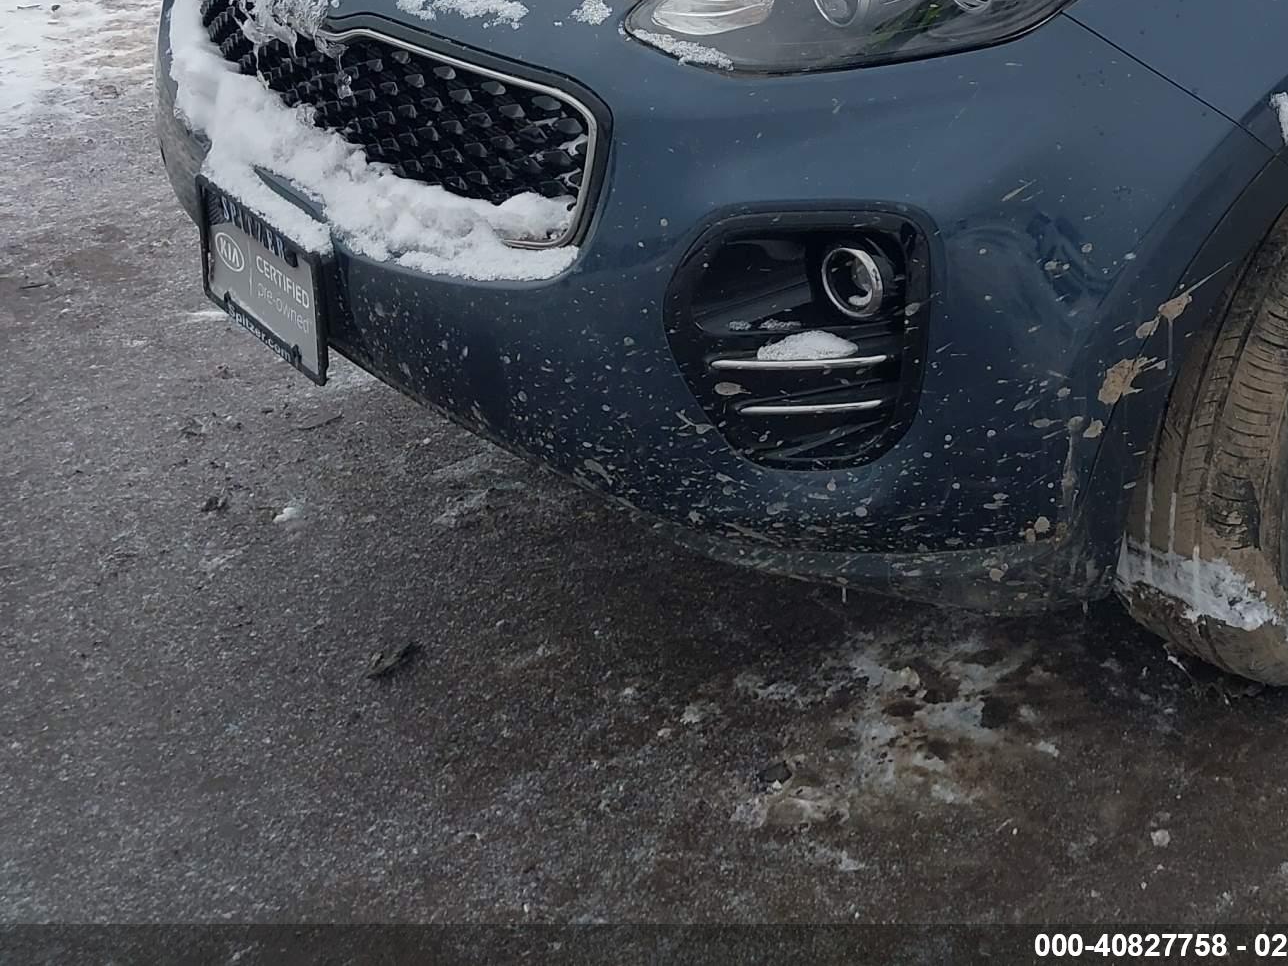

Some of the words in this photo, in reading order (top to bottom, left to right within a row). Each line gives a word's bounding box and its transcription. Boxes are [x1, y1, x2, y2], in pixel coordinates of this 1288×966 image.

[219, 238, 240, 269] KIA
[256, 255, 310, 309] CERTIFIED
[228, 304, 292, 363] Spitzer.com
